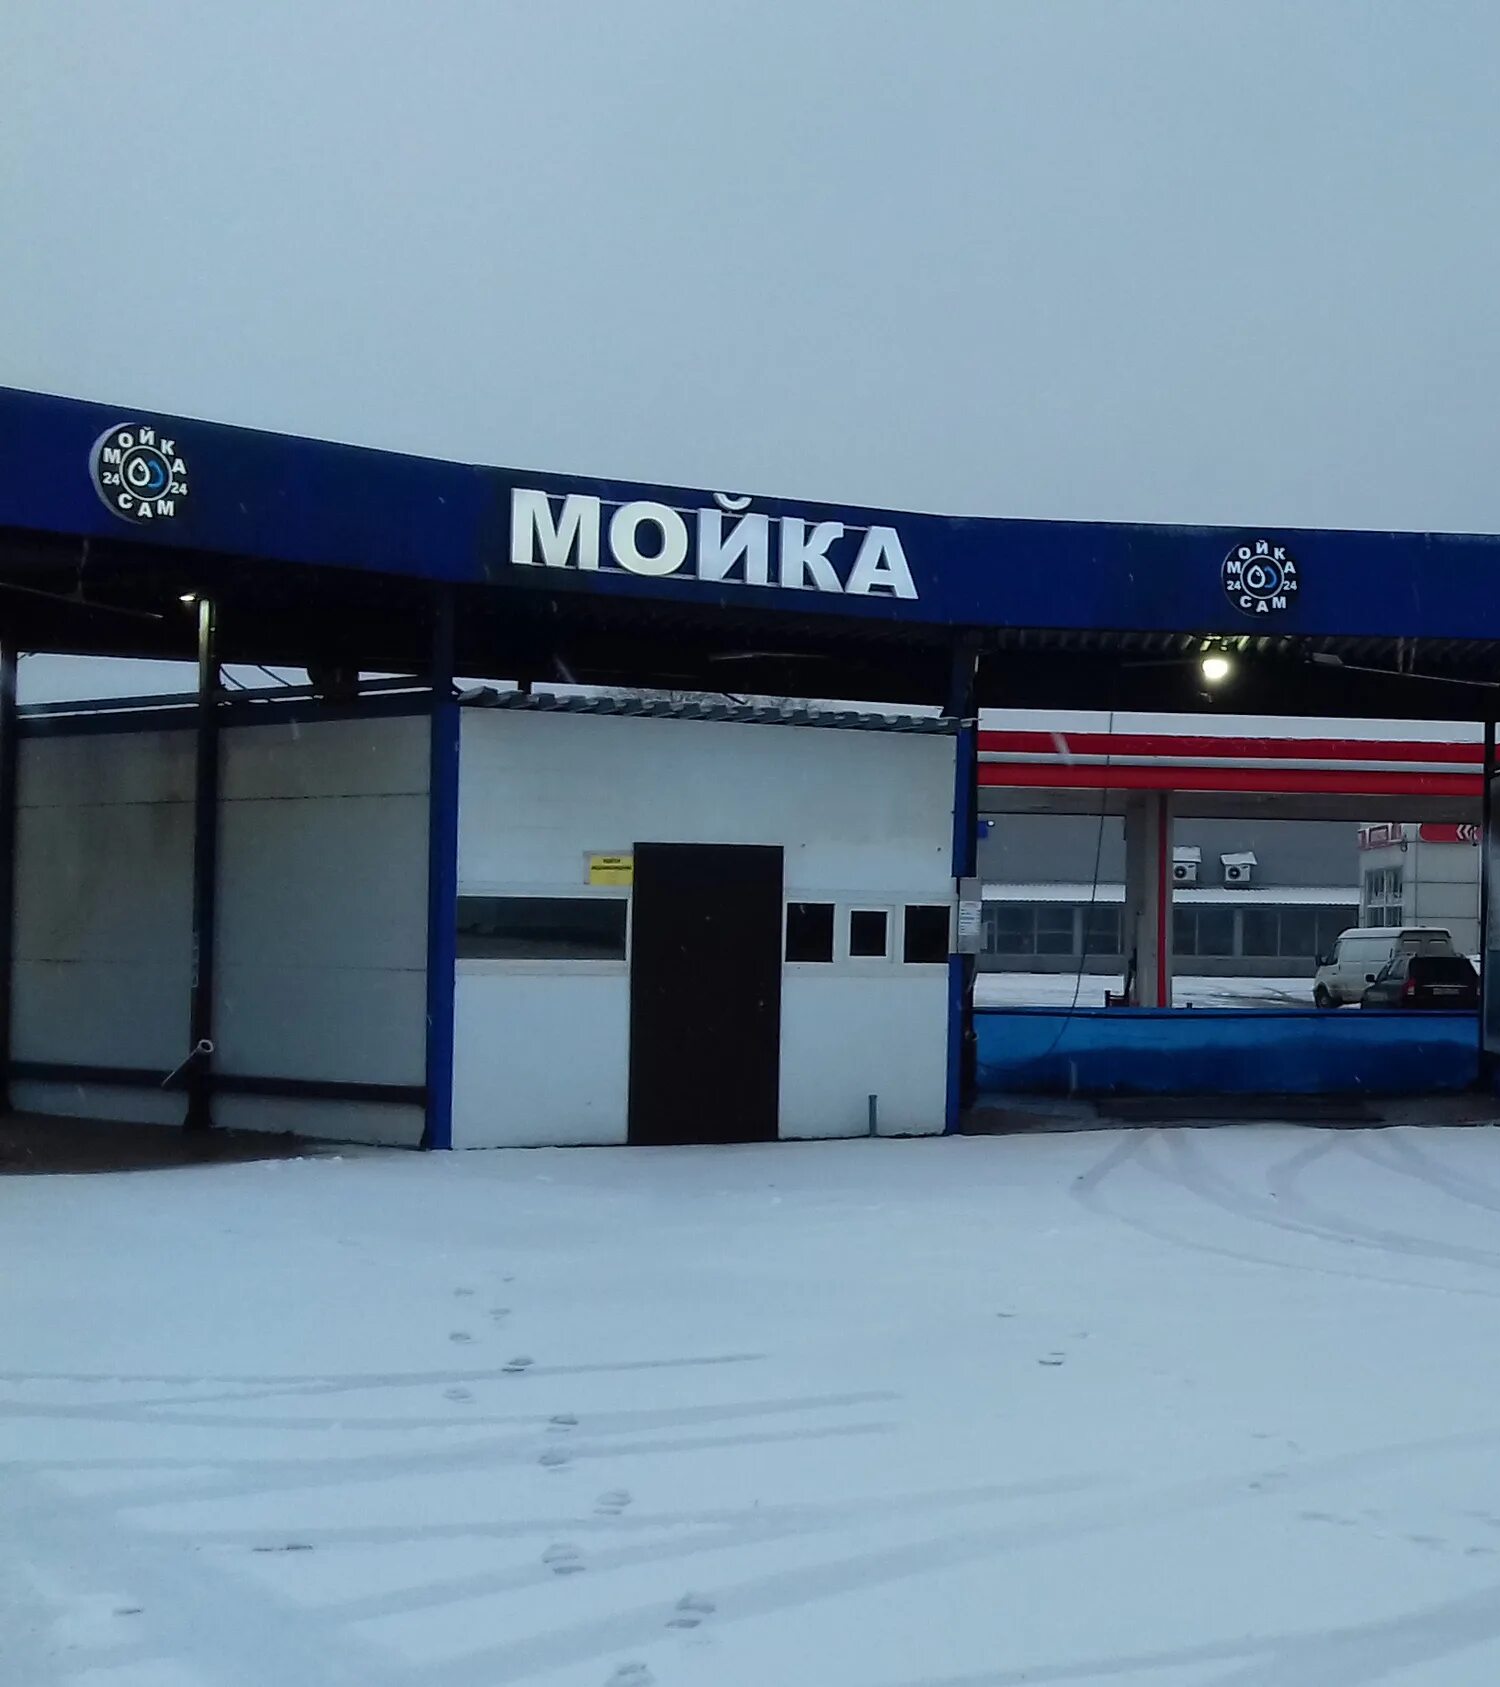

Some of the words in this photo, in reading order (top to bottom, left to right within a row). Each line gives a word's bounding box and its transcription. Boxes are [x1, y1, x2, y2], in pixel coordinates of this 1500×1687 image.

[102, 426, 188, 475] МОЙКА
[103, 472, 120, 485] 24
[170, 482, 188, 496] 24
[117, 493, 175, 518] САМ
[510, 487, 919, 600] МОЙКА
[1226, 539, 1297, 574] МОЙКА
[1226, 580, 1242, 591] 24
[1282, 580, 1298, 591] 24
[1239, 595, 1287, 613] САМ
